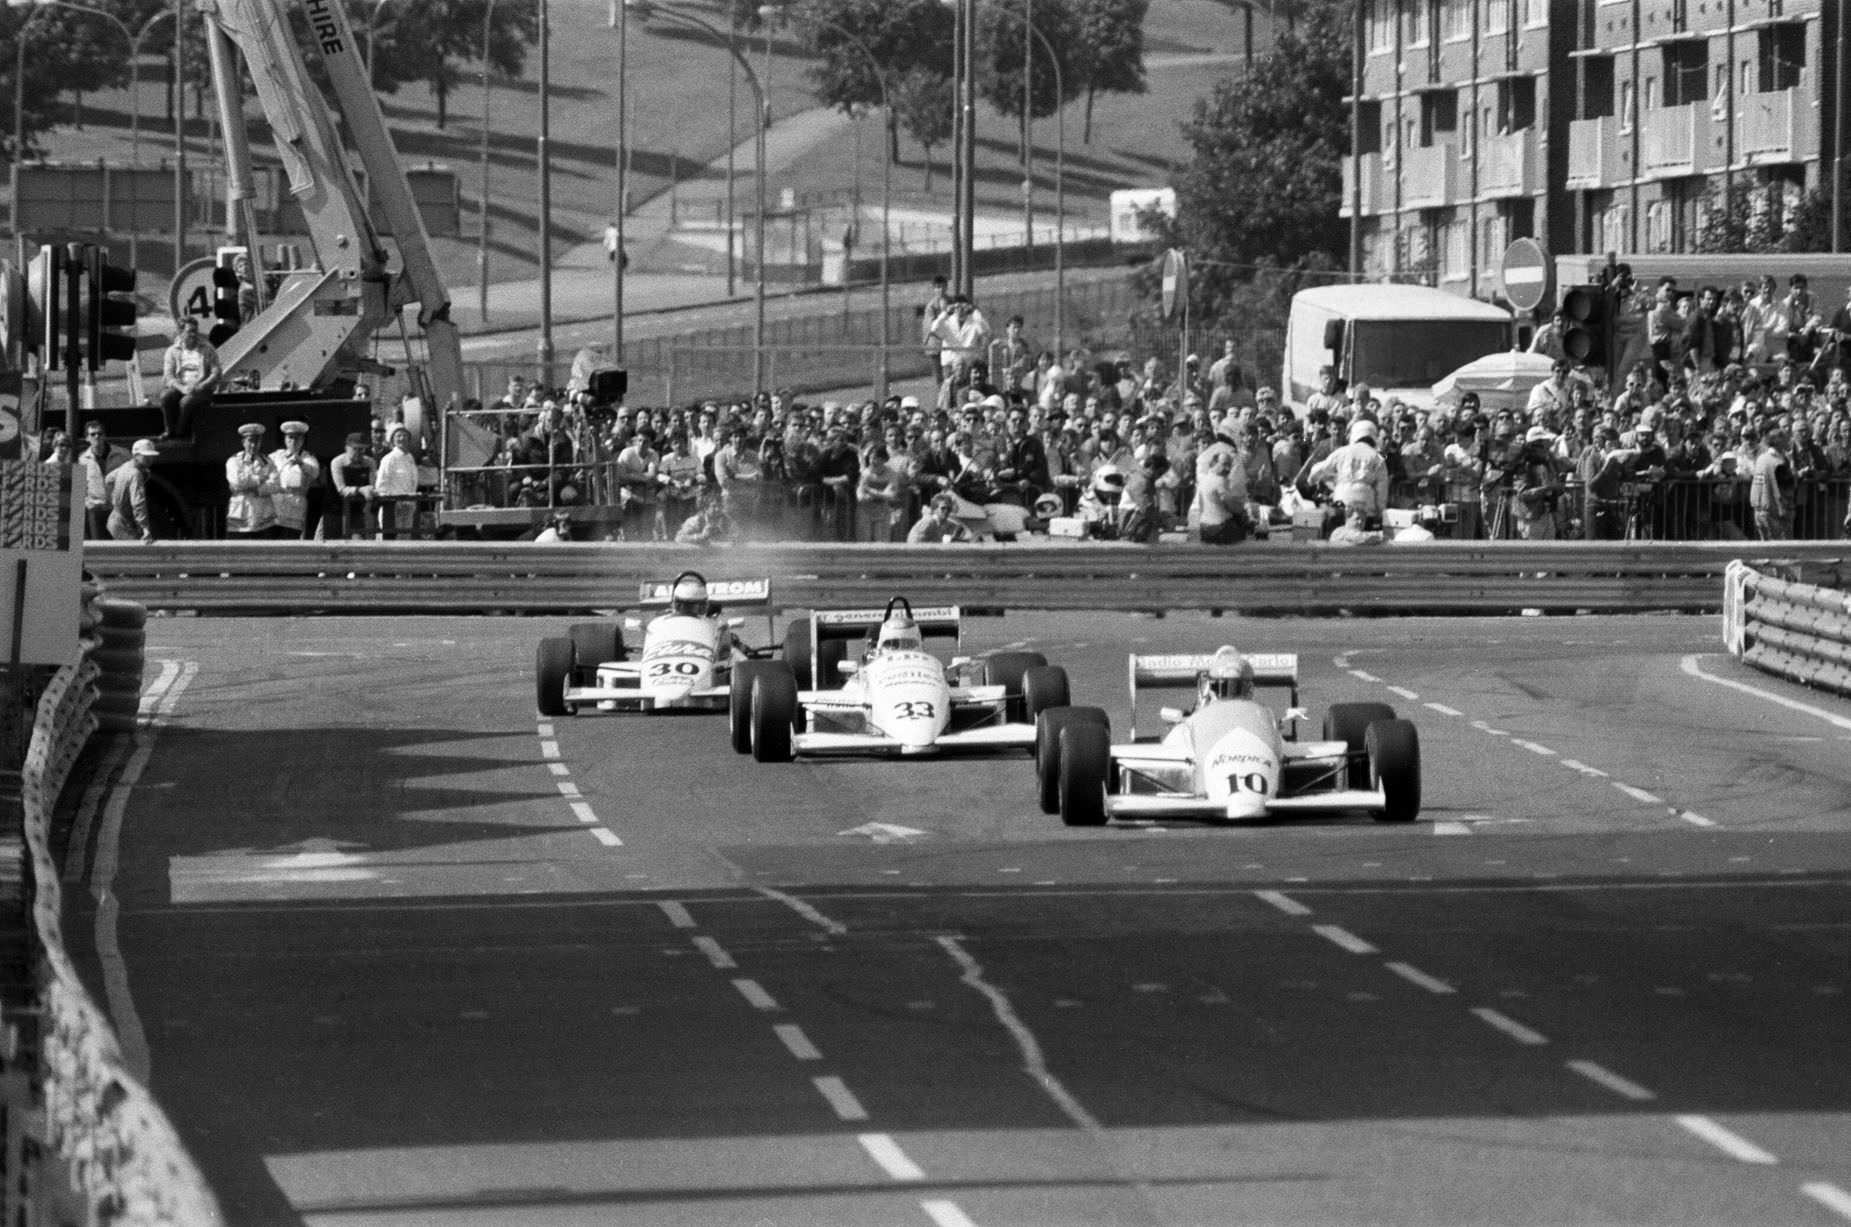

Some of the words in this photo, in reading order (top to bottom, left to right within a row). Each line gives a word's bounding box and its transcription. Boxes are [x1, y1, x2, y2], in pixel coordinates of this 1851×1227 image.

[306, 0, 343, 55] HIRE
[648, 662, 700, 677] 30
[893, 701, 935, 719] 33
[1225, 771, 1269, 796] 10
